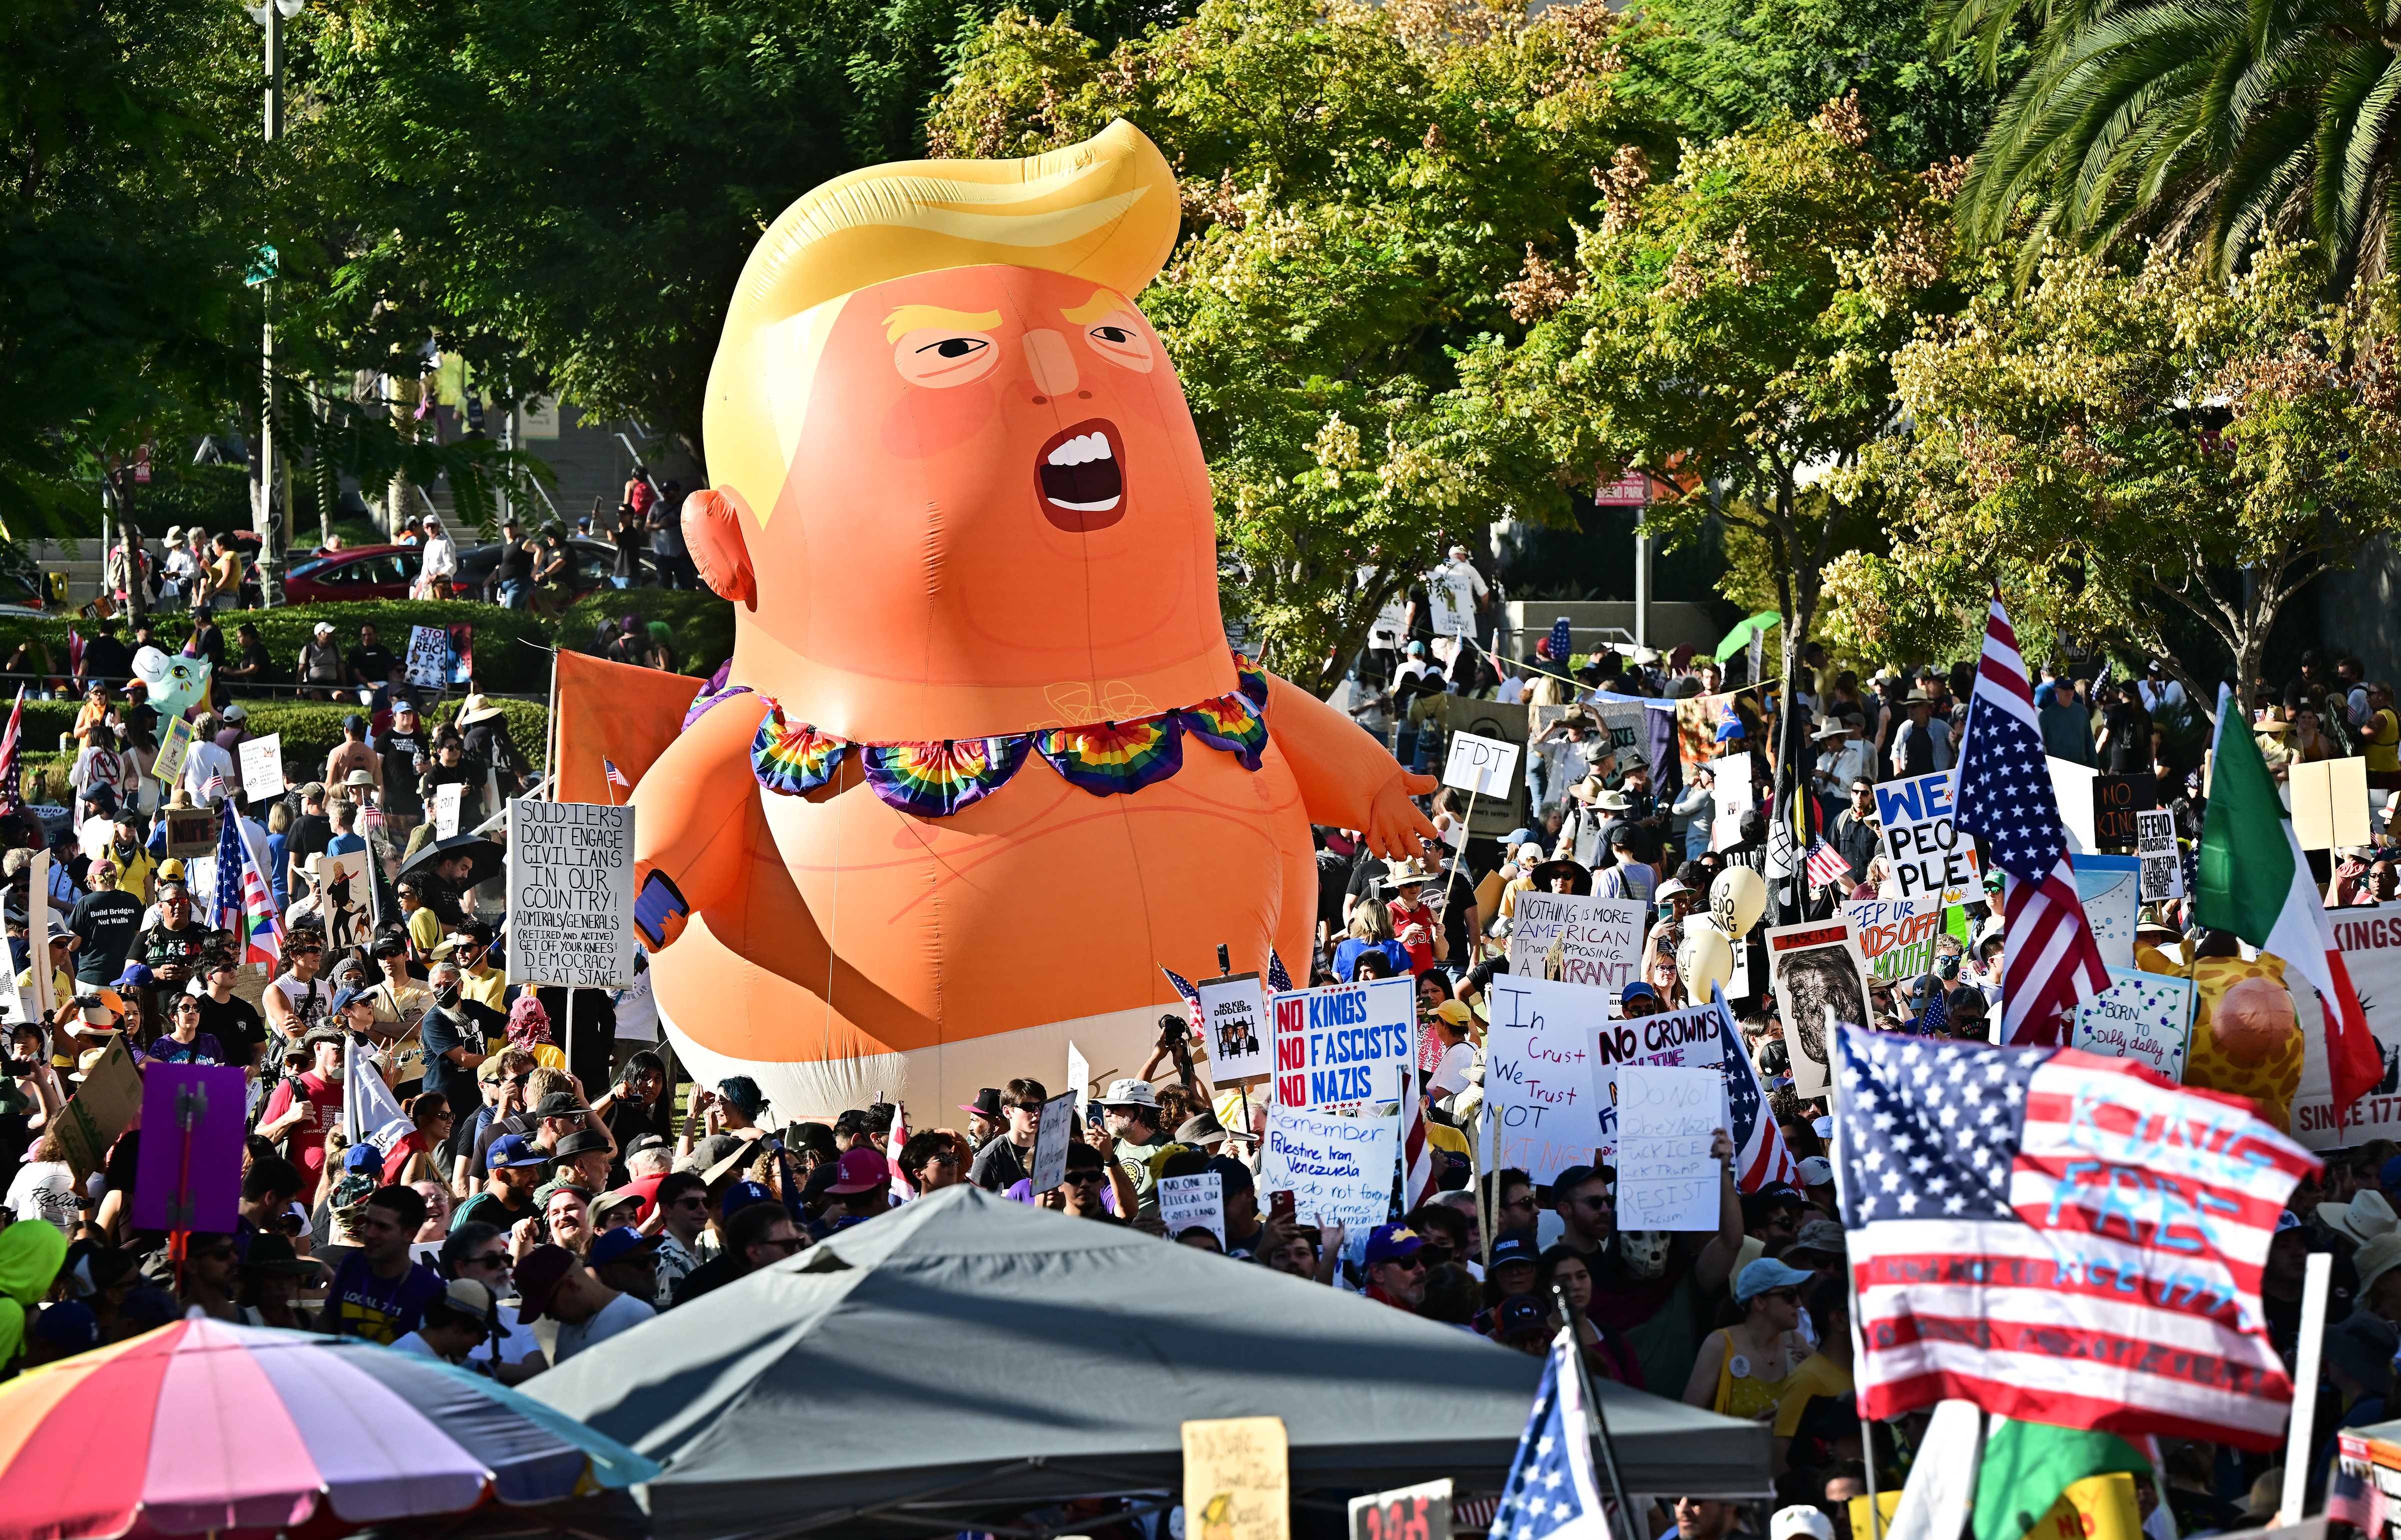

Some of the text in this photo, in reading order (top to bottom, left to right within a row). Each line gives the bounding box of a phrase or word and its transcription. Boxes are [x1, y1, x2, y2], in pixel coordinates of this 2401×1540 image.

[1625, 486, 1644, 499] PARK
[1455, 739, 1510, 773] FDT
[246, 778, 257, 788] NO
[1875, 773, 1953, 826] WE
[2103, 782, 2131, 805] NO
[521, 800, 622, 827] SOLDIERS
[521, 824, 623, 848] DON'T ENGAGE
[1887, 818, 1960, 860] PEO
[522, 845, 622, 868] CIVILIANS
[2147, 855, 2177, 872] TIME FOR
[530, 866, 609, 891] IN OUR
[1406, 865, 1413, 875] LA
[2145, 868, 2174, 884] GENERAL
[522, 887, 617, 911] COUNTRY!
[1713, 881, 1730, 897] NO
[2146, 883, 2170, 899] STRIKE!
[90, 908, 135, 918] Build Bridges
[1520, 898, 1633, 925] NOTHING IS MORE
[1709, 893, 1735, 915] PEDO
[1894, 901, 1914, 921] UR
[514, 910, 619, 930] ADMIRALS/GENERALS
[1898, 911, 1941, 946] OFF
[518, 928, 561, 939] (RETIRED
[581, 931, 614, 941] ACTIVE)
[1517, 921, 1630, 947] AMERICAN
[1786, 928, 1832, 949] FASCIST
[519, 940, 618, 954] GET OFF YOUR KNEES!
[524, 952, 616, 970] DEMOCRACY
[525, 967, 622, 986] IS AT STAKE!
[1519, 958, 1532, 977] A
[1541, 957, 1634, 987] YRANT
[636, 985, 647, 997] LAP
[1214, 1005, 1252, 1016] DIDDLERS
[1232, 1000, 1245, 1008] KID
[1277, 990, 1367, 1033] NO KINGS
[1499, 988, 1544, 1030] In
[2105, 1002, 2140, 1020] BORN
[1962, 1021, 1986, 1031] PIRATES
[1966, 1028, 1982, 1036] NEWS
[2135, 1022, 2150, 1036] TO
[295, 1040, 304, 1048] LA
[1278, 1023, 1408, 1071] NO FASCISTS
[1599, 1010, 1720, 1066] NO CROWNS
[1528, 1036, 1586, 1064] Crust
[2130, 1036, 2164, 1065] dally
[1494, 1055, 1522, 1085] We
[1279, 1065, 1372, 1107] NO NAZIS
[1525, 1080, 1577, 1105] Trust
[2066, 1082, 2277, 1184] KING
[1502, 1135, 1594, 1171] KINGS
[1666, 1140, 1705, 1158] ICE
[1133, 1159, 1144, 1177] COMPANY
[1287, 1156, 1360, 1177] Venezuela
[1163, 1179, 1179, 1191] NO
[1208, 1176, 1220, 1186] IS
[1266, 1168, 1299, 1191] We
[1302, 1181, 1323, 1195] do
[1332, 1183, 1355, 1199] not
[1204, 1191, 1218, 1201] ON
[1622, 1181, 1709, 1223] RESIST
[2046, 1161, 2241, 1251] FREE
[1194, 1207, 1217, 1216] LAND
[1321, 1203, 1370, 1215] Crimes
[1496, 1239, 1520, 1252] CHICAGO
[344, 1290, 377, 1308] LOCAL
